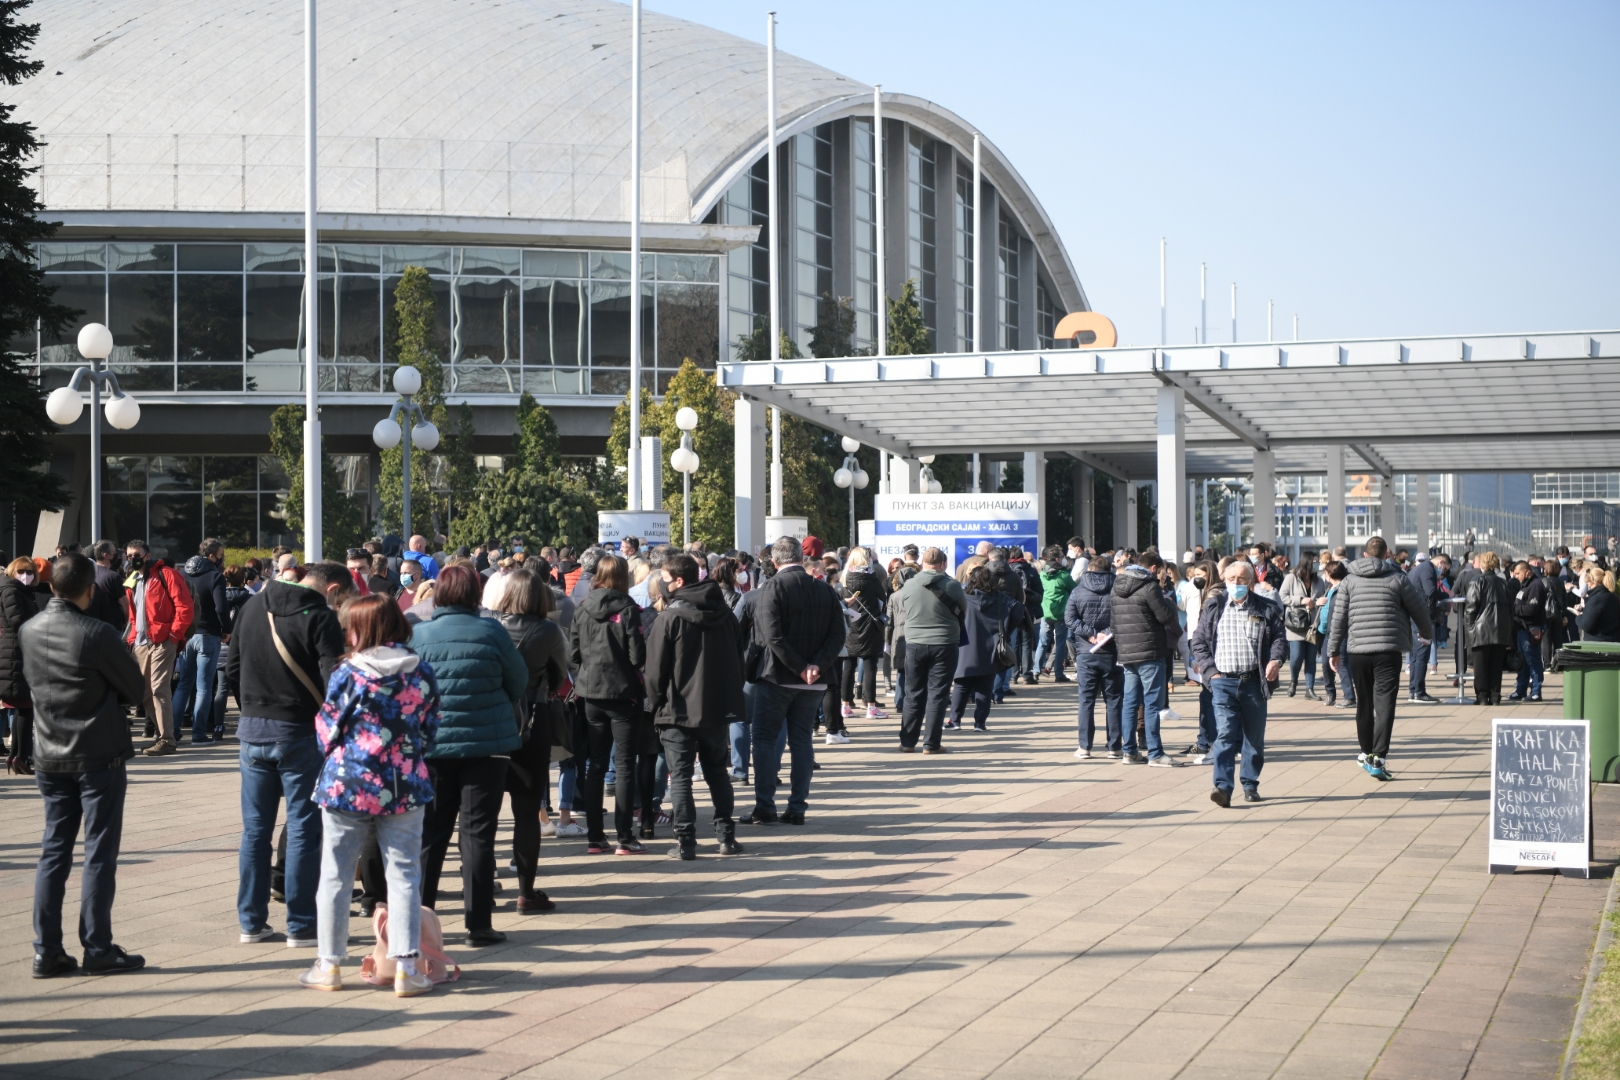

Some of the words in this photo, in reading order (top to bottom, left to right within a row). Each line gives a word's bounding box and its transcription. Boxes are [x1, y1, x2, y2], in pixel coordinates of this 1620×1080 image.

[1351, 474, 1371, 497] 2
[892, 501, 927, 510] ПУНКТ
[931, 501, 945, 510] ЗА
[949, 500, 1031, 511] ВАКЦИНАЦИЈУ
[896, 523, 950, 532] БЕОГРАДСКИ
[952, 523, 981, 531] САЈАМ
[988, 523, 1012, 531] ХАЛА
[1013, 523, 1019, 531] 3
[1500, 729, 1580, 751] TRAFIKA
[1518, 752, 1563, 772] HALA
[1563, 751, 1580, 778] 7
[1498, 771, 1526, 787] KAFA
[1527, 774, 1543, 787] ZA
